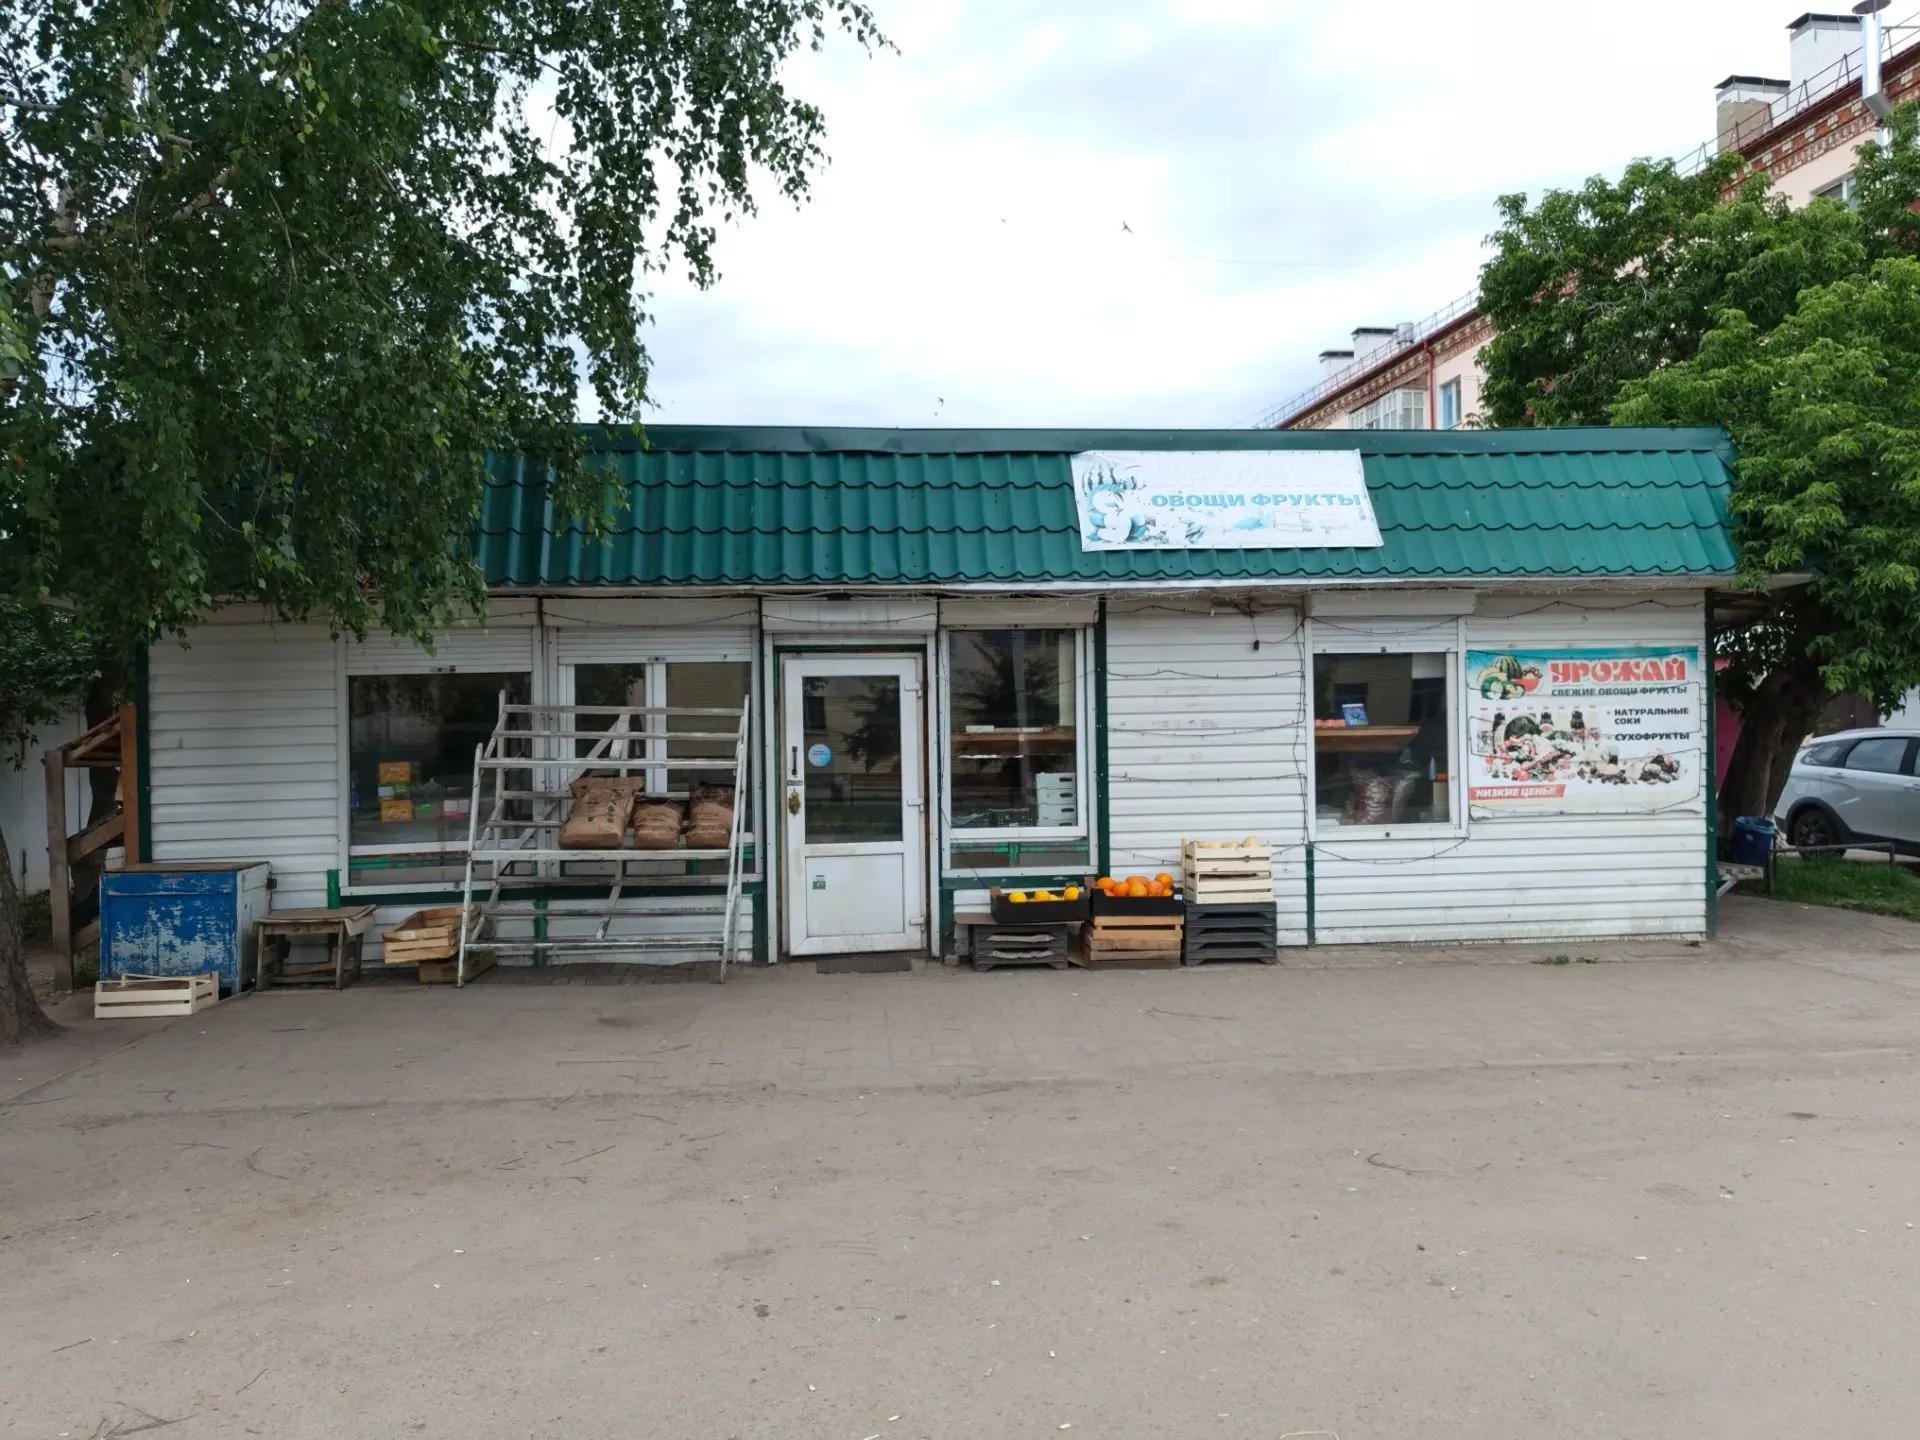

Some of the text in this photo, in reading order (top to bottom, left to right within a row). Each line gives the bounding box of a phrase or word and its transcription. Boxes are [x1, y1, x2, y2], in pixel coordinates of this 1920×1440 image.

[1151, 493, 1361, 508] ОВОЩИ ФРУКТЫ
[1550, 657, 1686, 683] УРОЖАЙ
[1551, 686, 1687, 697] СВЕЖИЕ ОВОЩИ ФРУКТЫ
[1614, 708, 1689, 716] НАТУРАЛЬНЫЕ
[1614, 717, 1641, 725] СОКИ
[1614, 732, 1690, 741] СУХОФРУКТЫ
[1476, 788, 1519, 798] НИЗКИЕ
